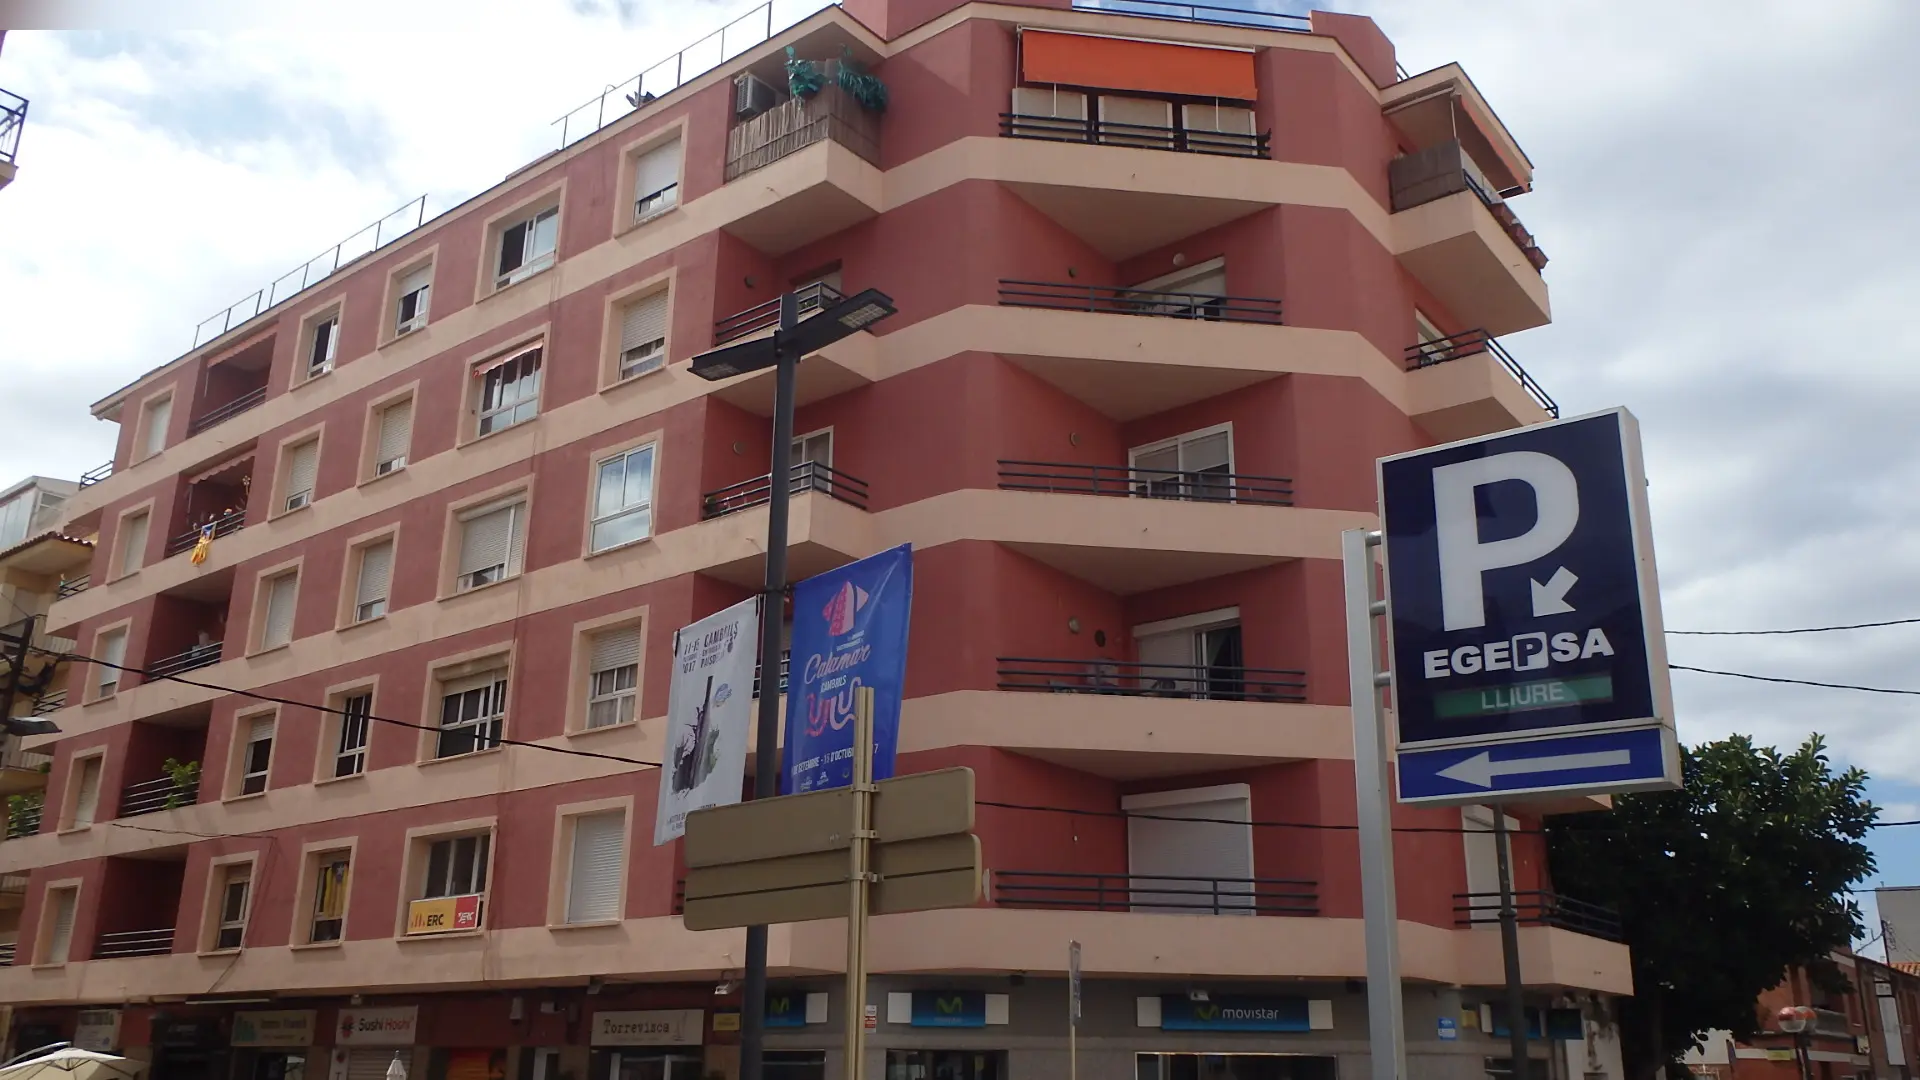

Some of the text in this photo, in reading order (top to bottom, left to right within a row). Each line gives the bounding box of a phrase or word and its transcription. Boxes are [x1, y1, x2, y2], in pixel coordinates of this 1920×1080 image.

[1432, 450, 1579, 632] P
[804, 644, 871, 685] Calamar
[1423, 628, 1614, 678] EGEPSA
[1481, 681, 1565, 710] LLIURE
[427, 913, 444, 926] ERC
[1222, 1008, 1279, 1020] movistar
